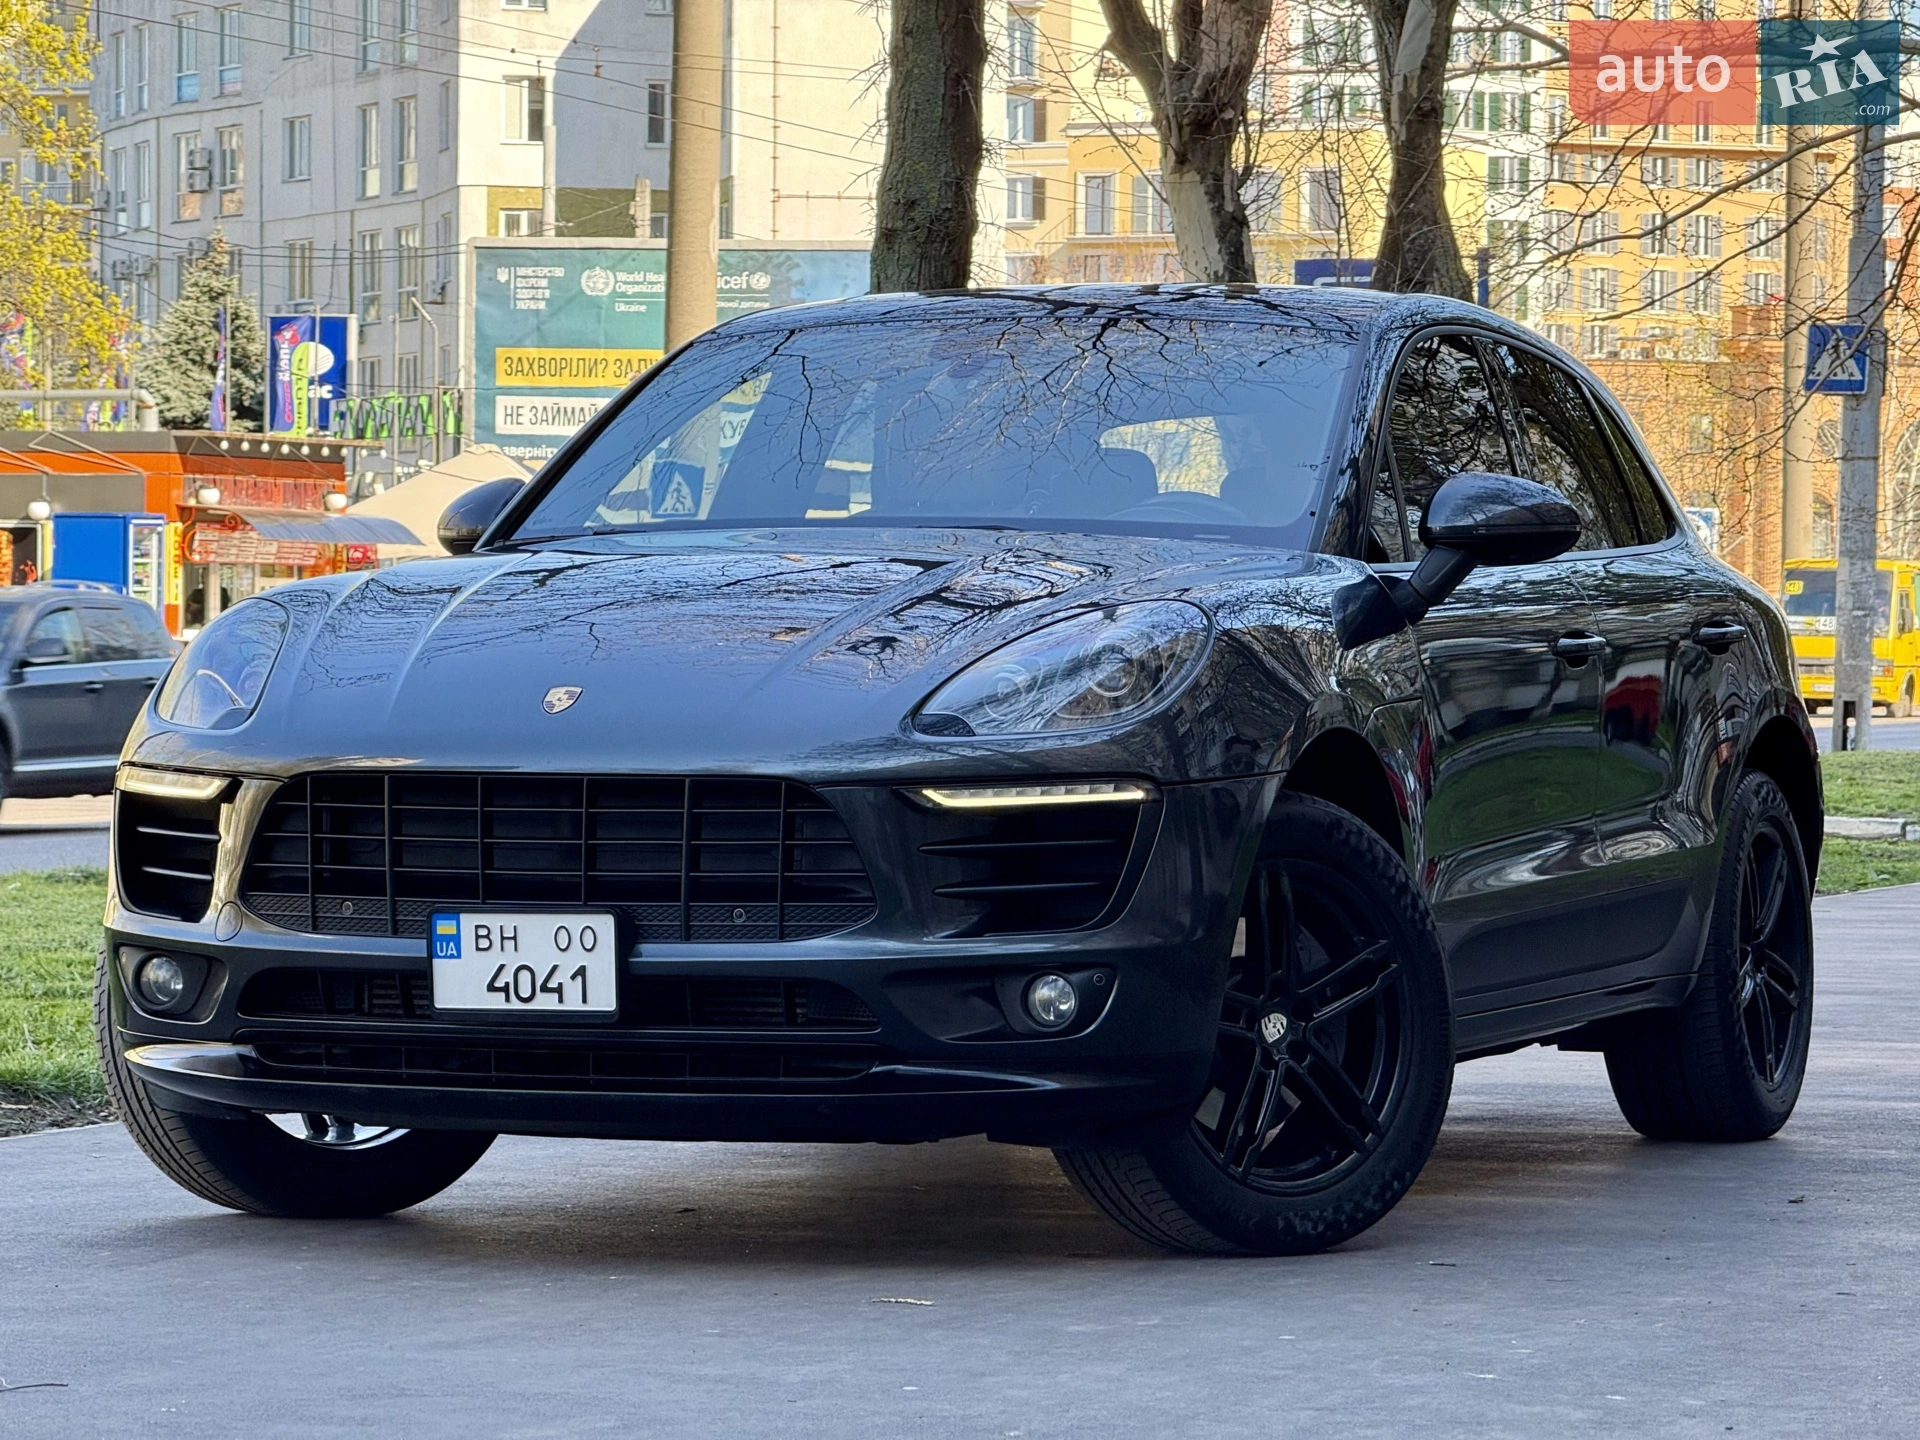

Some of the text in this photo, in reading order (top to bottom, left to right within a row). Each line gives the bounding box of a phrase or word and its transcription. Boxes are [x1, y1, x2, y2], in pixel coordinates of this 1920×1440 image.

[615, 271, 644, 282] World
[615, 302, 648, 312] Ukraine
[504, 356, 608, 378] ЗАХВОРІЛИ?
[503, 405, 525, 426] НЕ
[474, 924, 519, 952] BH
[436, 941, 458, 957] UA
[486, 963, 588, 1004] 4041
